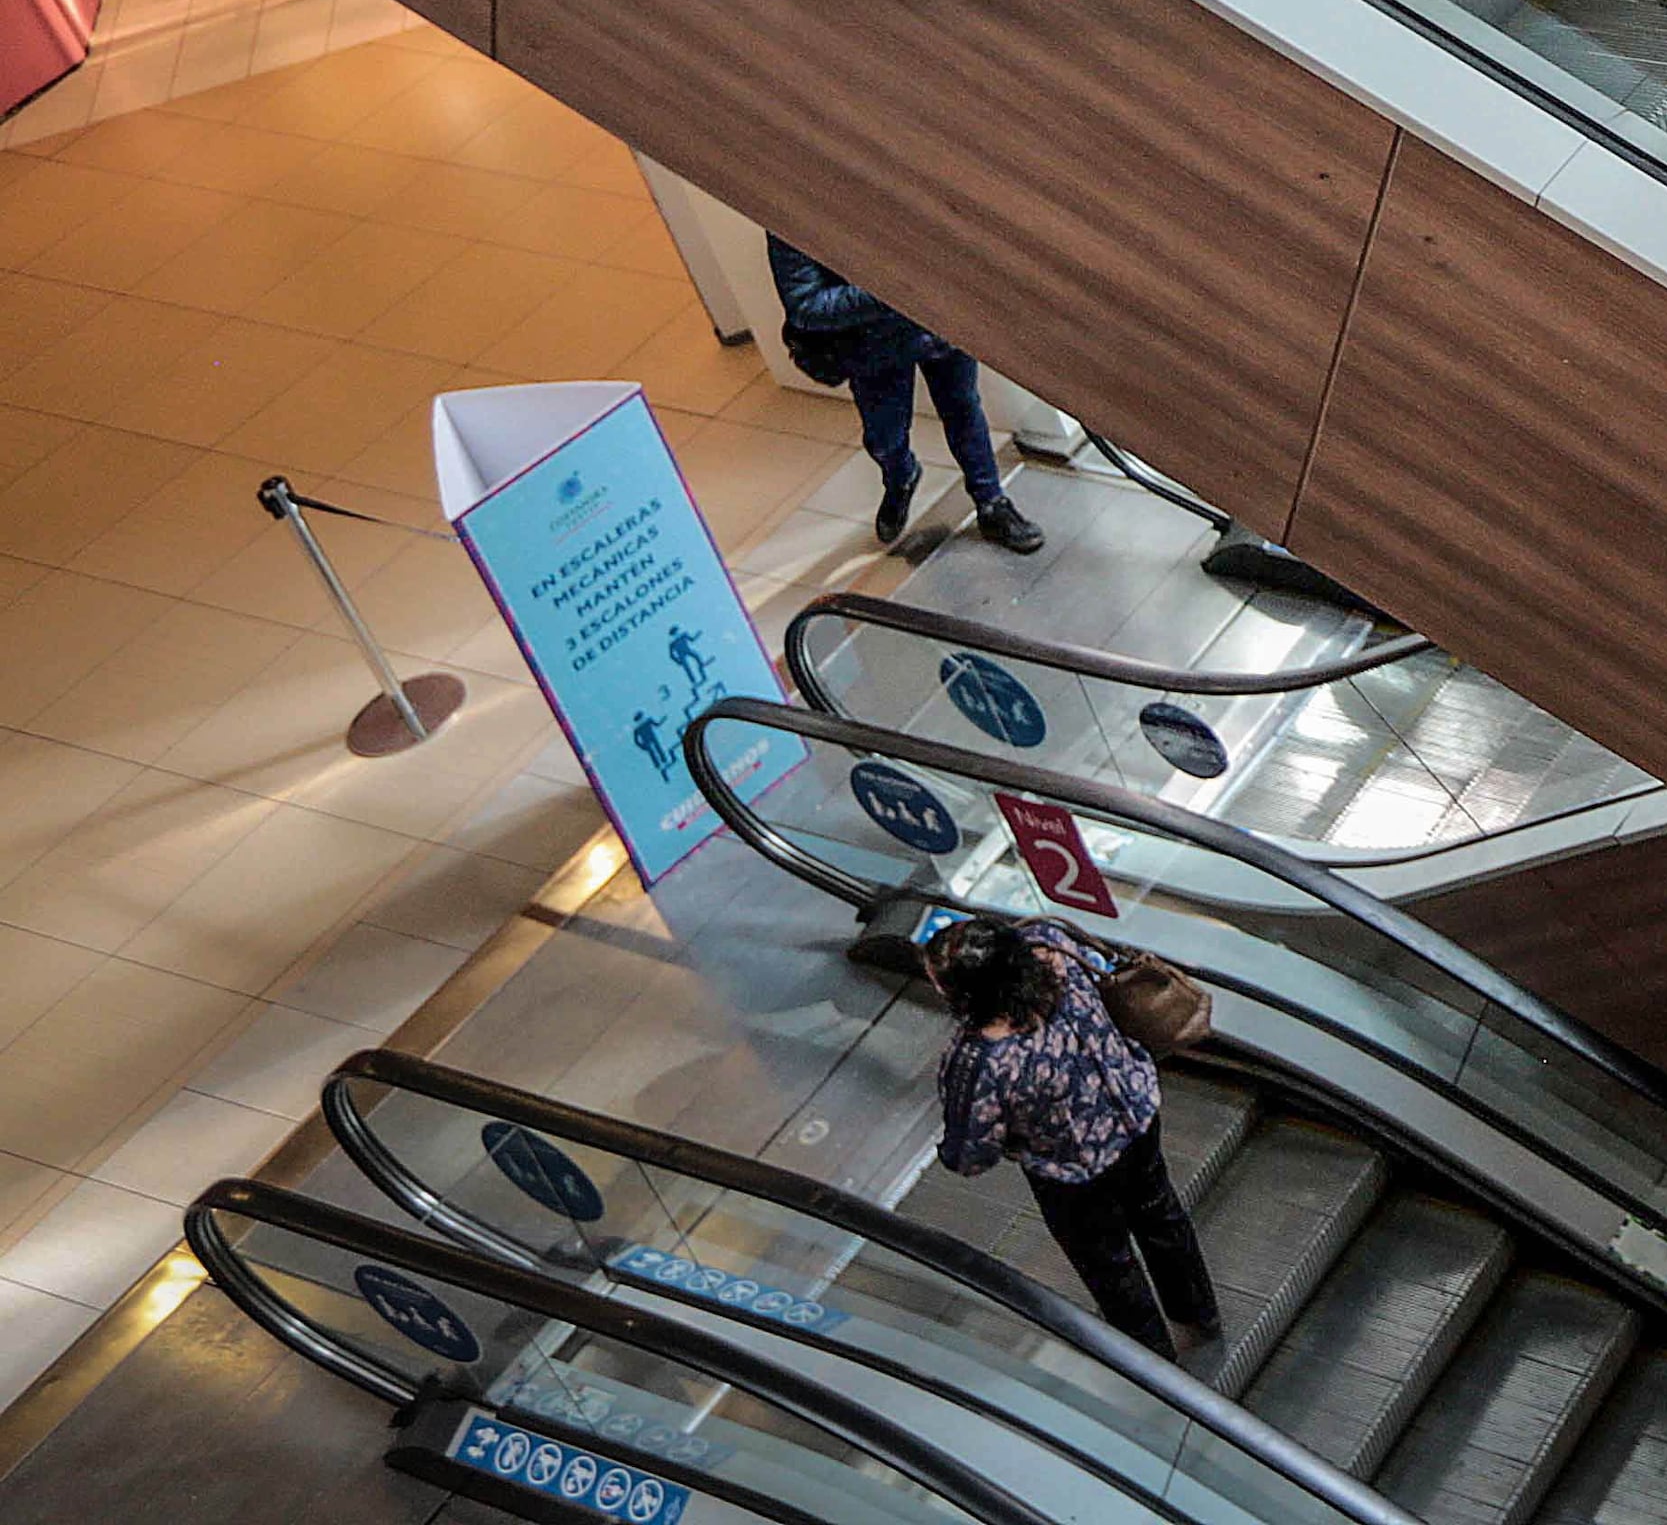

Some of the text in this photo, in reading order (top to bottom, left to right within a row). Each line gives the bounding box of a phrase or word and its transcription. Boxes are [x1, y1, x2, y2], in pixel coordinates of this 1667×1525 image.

[532, 574, 557, 598] EN
[559, 498, 662, 578] ESCALERAS
[566, 557, 683, 651] 3 ESCALONES
[572, 575, 695, 672] DE DISTANCIA
[1013, 807, 1067, 835] Nivel
[1033, 839, 1098, 903] 2
